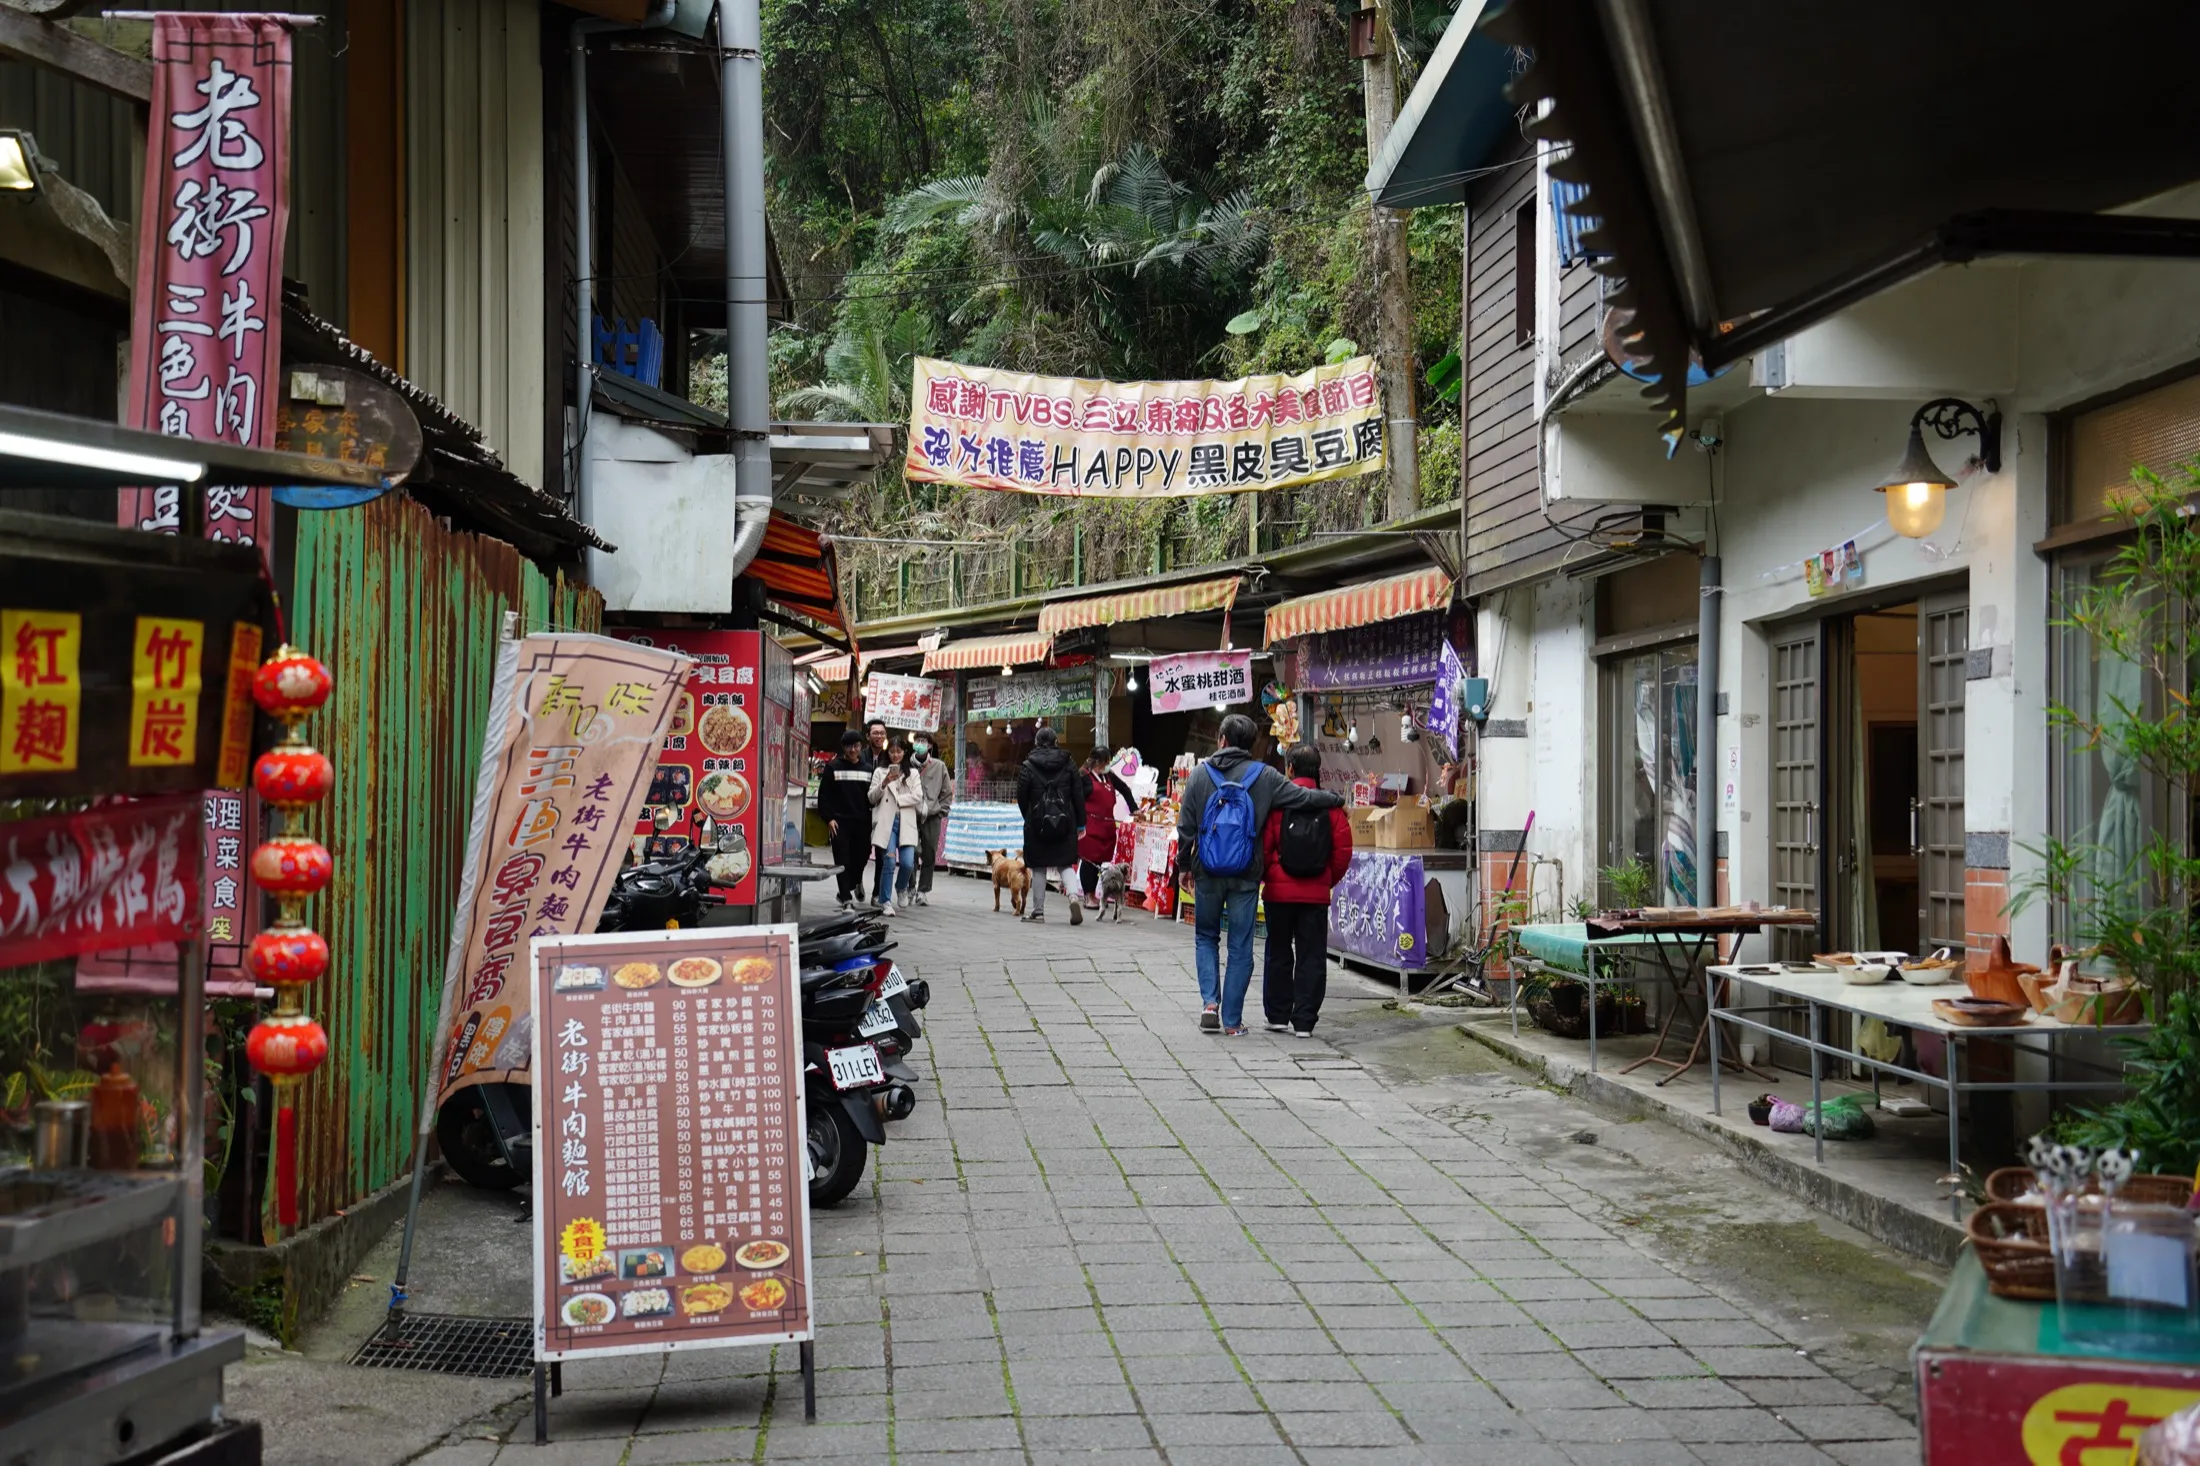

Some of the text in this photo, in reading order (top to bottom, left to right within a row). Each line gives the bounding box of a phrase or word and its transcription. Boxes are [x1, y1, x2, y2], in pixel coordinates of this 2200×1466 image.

[1051, 443, 1182, 490] HAPPY
[1188, 417, 1384, 486] 黑皮臭豆腐
[1165, 668, 1244, 693] 水蜜桃甜酒
[13, 619, 68, 765] 紅麴
[140, 625, 194, 761] 竹炭
[1209, 687, 1246, 702] 桂花酒釀
[703, 759, 745, 771] 麻辣鍋
[601, 1000, 686, 1014] 老街牛肉麵 90
[696, 996, 774, 1010] 客家炒飯 70
[673, 1012, 686, 1022] 65
[762, 1009, 774, 1018] 70
[674, 1024, 688, 1034] 55
[762, 1022, 775, 1032] 70
[674, 1036, 688, 1046] 55
[698, 1036, 776, 1049] 炒青菜 80
[674, 1048, 688, 1058] 50
[763, 1049, 776, 1058] 90
[675, 1060, 688, 1070] 50
[764, 1062, 776, 1072] 90
[676, 1072, 689, 1082] 50
[762, 1076, 780, 1085] 100
[676, 1084, 689, 1094] 35
[763, 1089, 781, 1098] 100
[676, 1096, 690, 1106] 20
[557, 1018, 591, 1198] 老街牛肉麵館
[677, 1108, 690, 1118] 50
[700, 1102, 782, 1116] 炒牛肉 110
[764, 1116, 782, 1126] 110
[604, 1120, 691, 1134] 三色臭豆腐 50
[604, 1132, 691, 1147] 竹炭臭豆腐 50
[700, 1130, 782, 1143] 炒山豬肉 170
[678, 1144, 692, 1154] 50
[764, 1143, 783, 1152] 170
[678, 1156, 692, 1166] 50
[702, 1156, 784, 1170] 客家小炒 170
[679, 1168, 692, 1178] 50
[768, 1170, 781, 1180] 55
[680, 1180, 693, 1190] 50
[703, 1183, 782, 1198] 牛肉湯 55
[680, 1193, 693, 1203] 65
[769, 1198, 782, 1208] 45
[606, 1205, 694, 1221] 麻辣臭豆腐 65
[770, 1212, 783, 1222] 40
[680, 1218, 694, 1228] 65
[681, 1230, 694, 1240] 65
[770, 1226, 784, 1236] 30
[573, 1223, 593, 1259] 素食可
